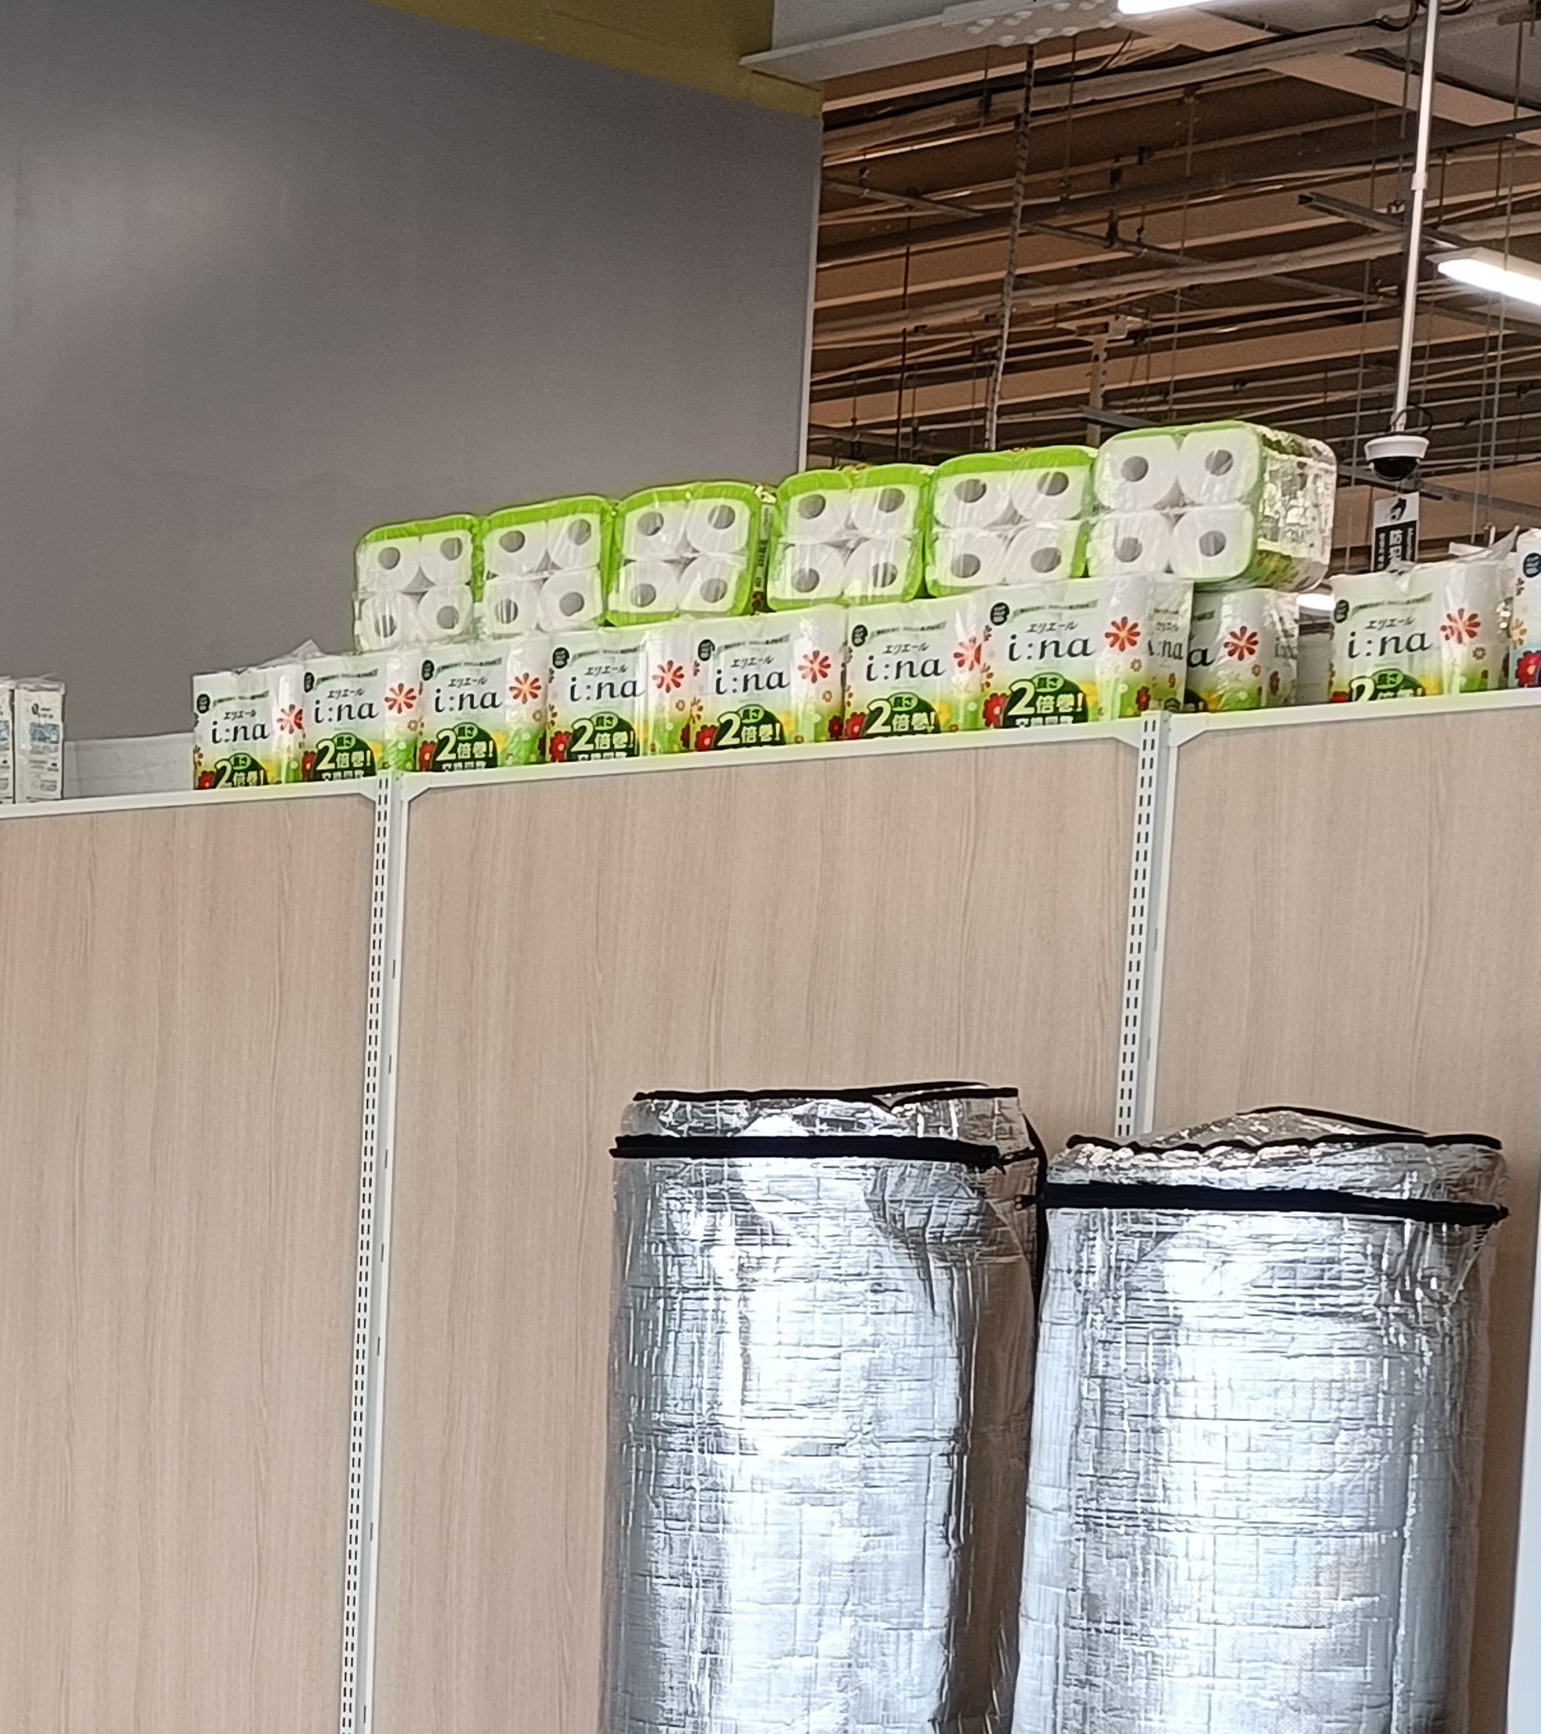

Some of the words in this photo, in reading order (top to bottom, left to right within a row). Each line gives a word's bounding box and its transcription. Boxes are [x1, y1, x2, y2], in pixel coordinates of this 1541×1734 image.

[1026, 619, 1079, 634] エリエール
[1364, 615, 1416, 632] エリエール
[883, 641, 930, 655] エリエール
[1008, 633, 1096, 662] i:na
[585, 663, 628, 677] エリエール
[731, 654, 775, 668] エリエール
[866, 654, 946, 682] i:na
[448, 676, 488, 688] エリエール
[569, 675, 646, 702] i:na
[715, 668, 790, 695] i:na
[327, 687, 366, 700] エリエール
[434, 687, 502, 713] i:na
[314, 699, 379, 724] i:na
[211, 720, 271, 744] i:na
